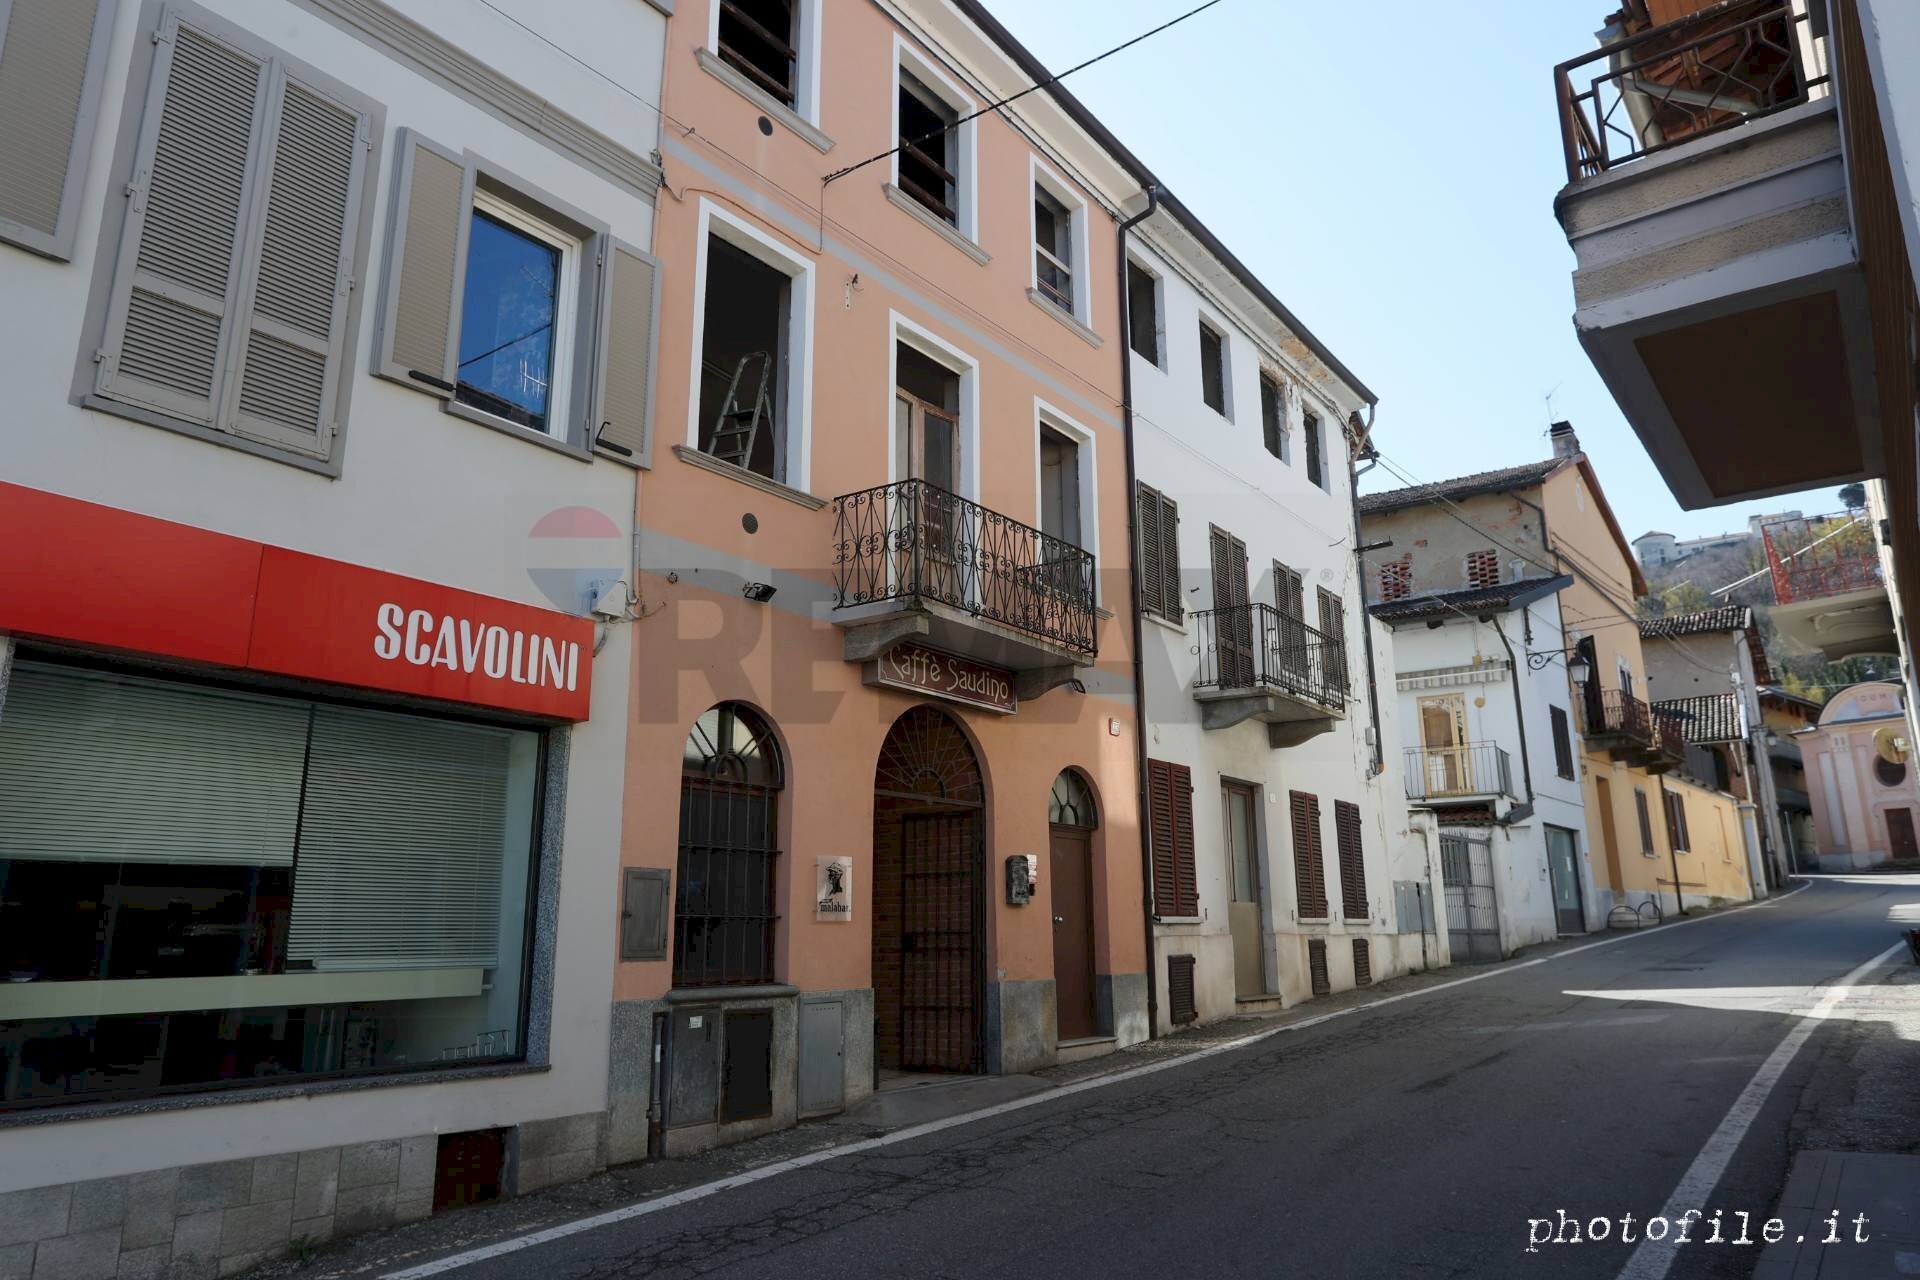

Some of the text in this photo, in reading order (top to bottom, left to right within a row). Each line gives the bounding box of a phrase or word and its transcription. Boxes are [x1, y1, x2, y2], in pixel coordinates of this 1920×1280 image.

[373, 602, 579, 692] SCAVOLINI
[889, 645, 1009, 703] Caffè Saudino
